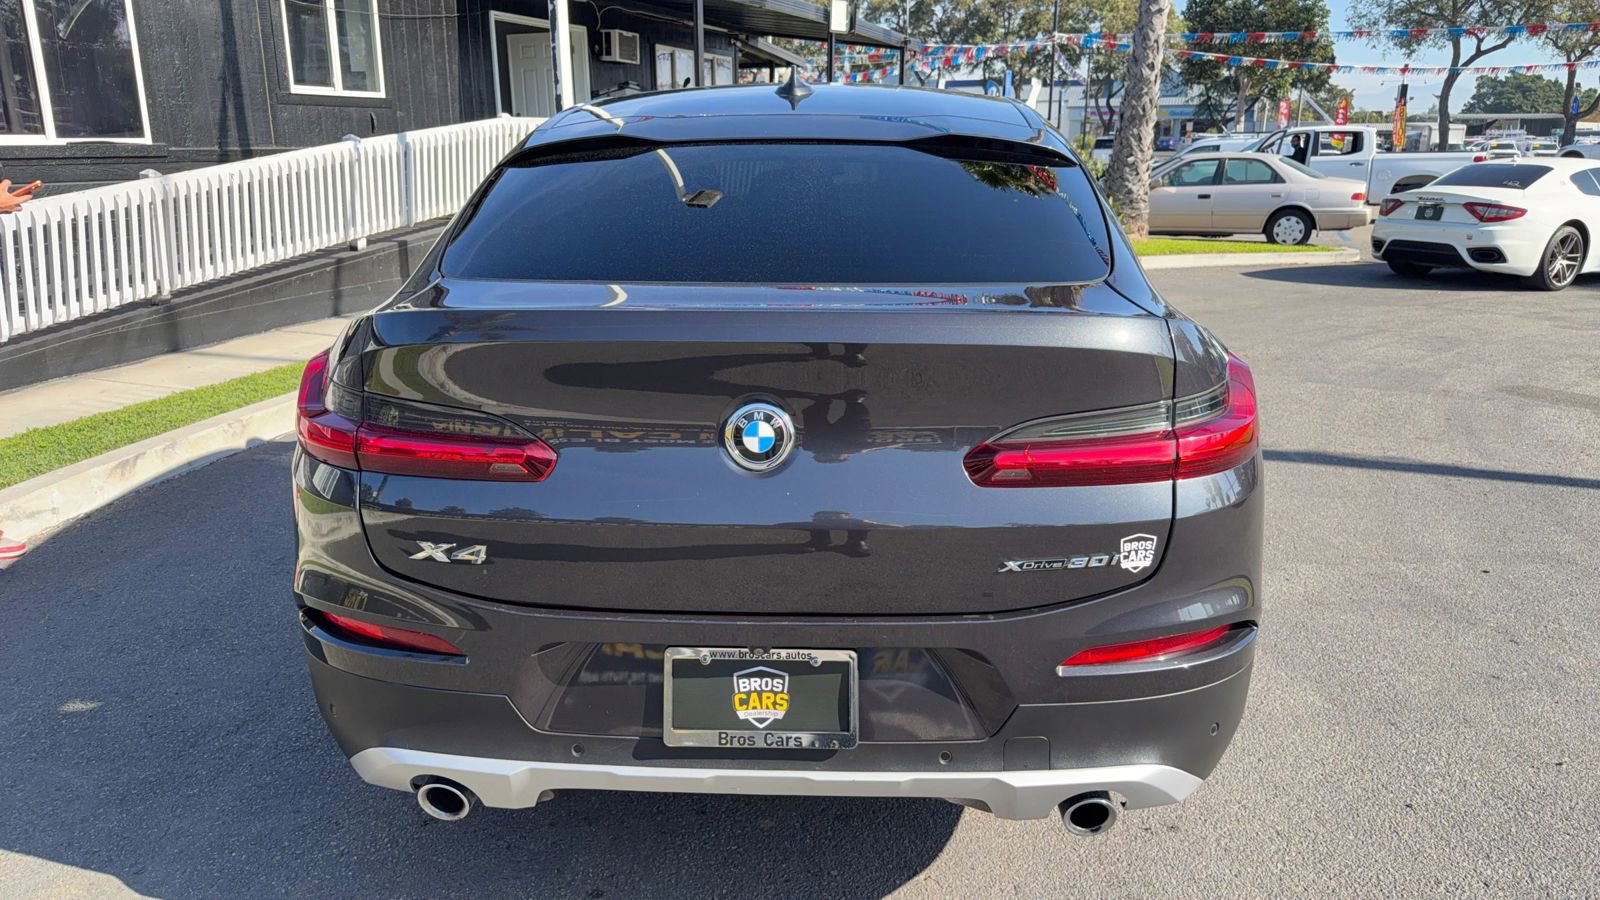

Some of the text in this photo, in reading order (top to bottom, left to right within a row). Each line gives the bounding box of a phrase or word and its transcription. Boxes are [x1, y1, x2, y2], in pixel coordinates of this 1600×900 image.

[738, 412, 781, 429] BMW
[408, 541, 487, 564] X4
[1123, 541, 1153, 551] BROS
[1120, 550, 1154, 562] CARS
[709, 650, 812, 660] www.broscars.autos
[738, 678, 783, 692] BROS
[734, 692, 789, 711] CARS
[718, 732, 803, 747] Bros Cars
